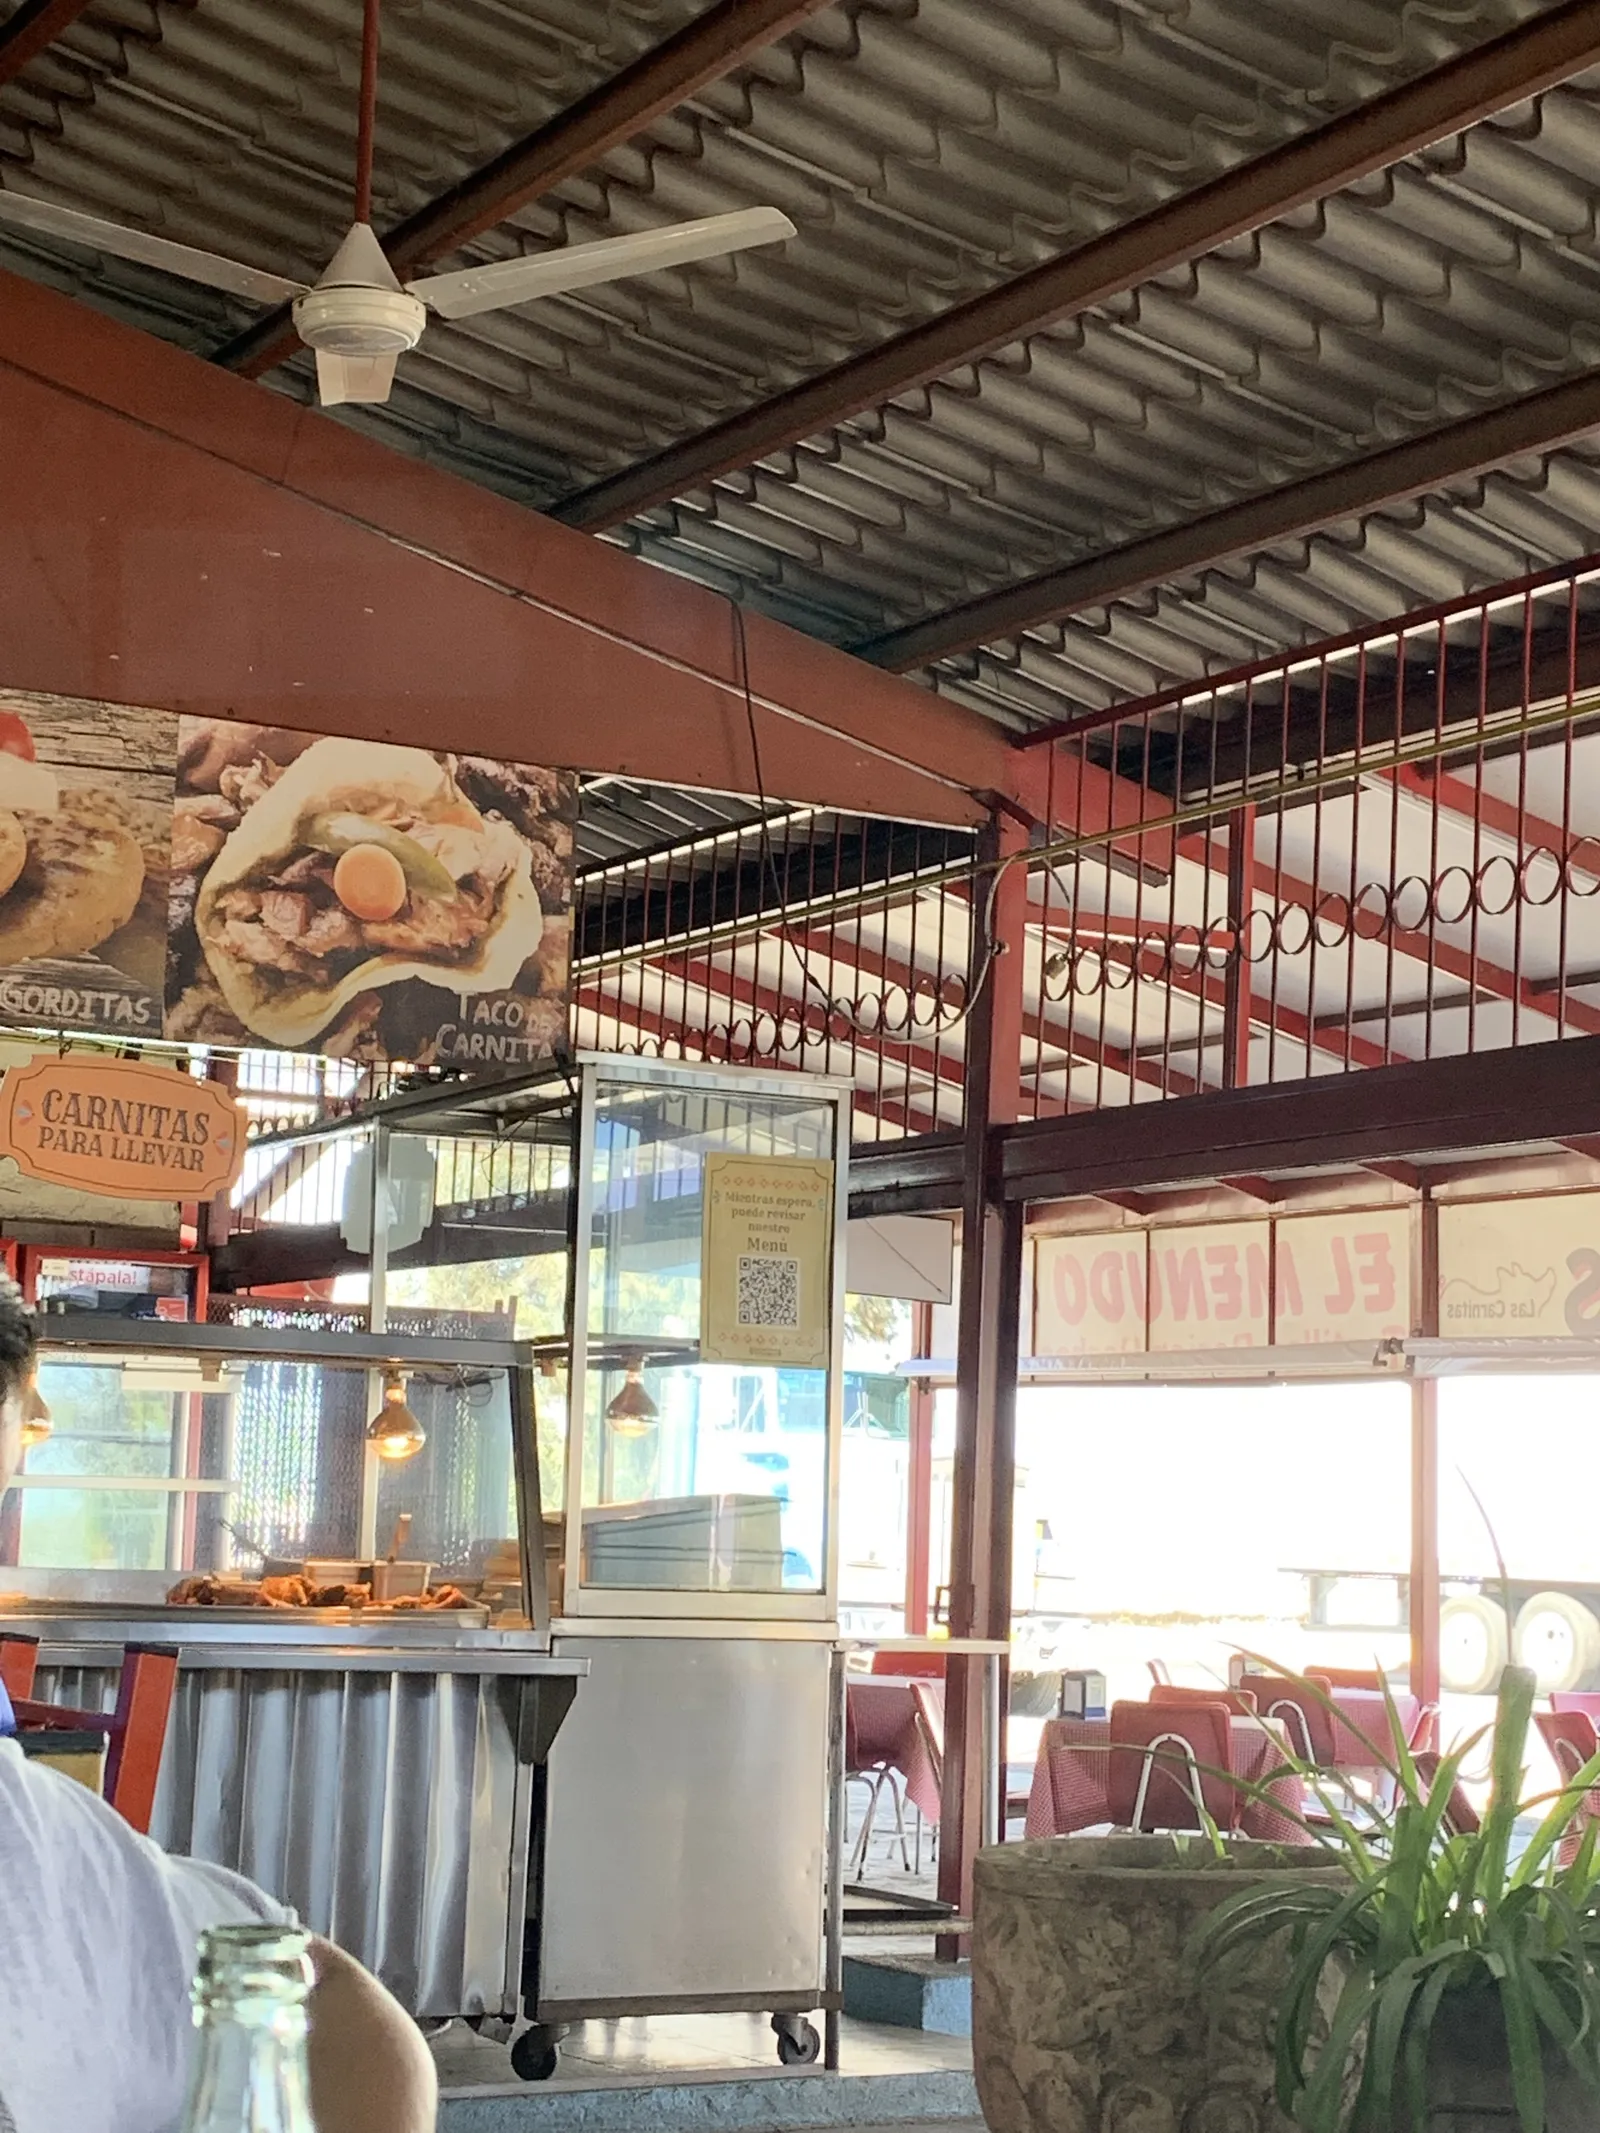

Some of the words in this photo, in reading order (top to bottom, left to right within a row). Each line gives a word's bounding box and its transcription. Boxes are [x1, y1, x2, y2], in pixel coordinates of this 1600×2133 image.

[0, 975, 153, 1025] GORDITAS
[458, 991, 524, 1028] TACO
[41, 1088, 210, 1147] CARNITAS
[37, 1125, 103, 1158] PARA
[111, 1137, 205, 1173] LLEVAR
[725, 1192, 774, 1205] Mientras
[731, 1207, 765, 1219] puede
[766, 1209, 806, 1221] revisar
[748, 1222, 790, 1233] nuestro
[746, 1237, 788, 1253] Menú
